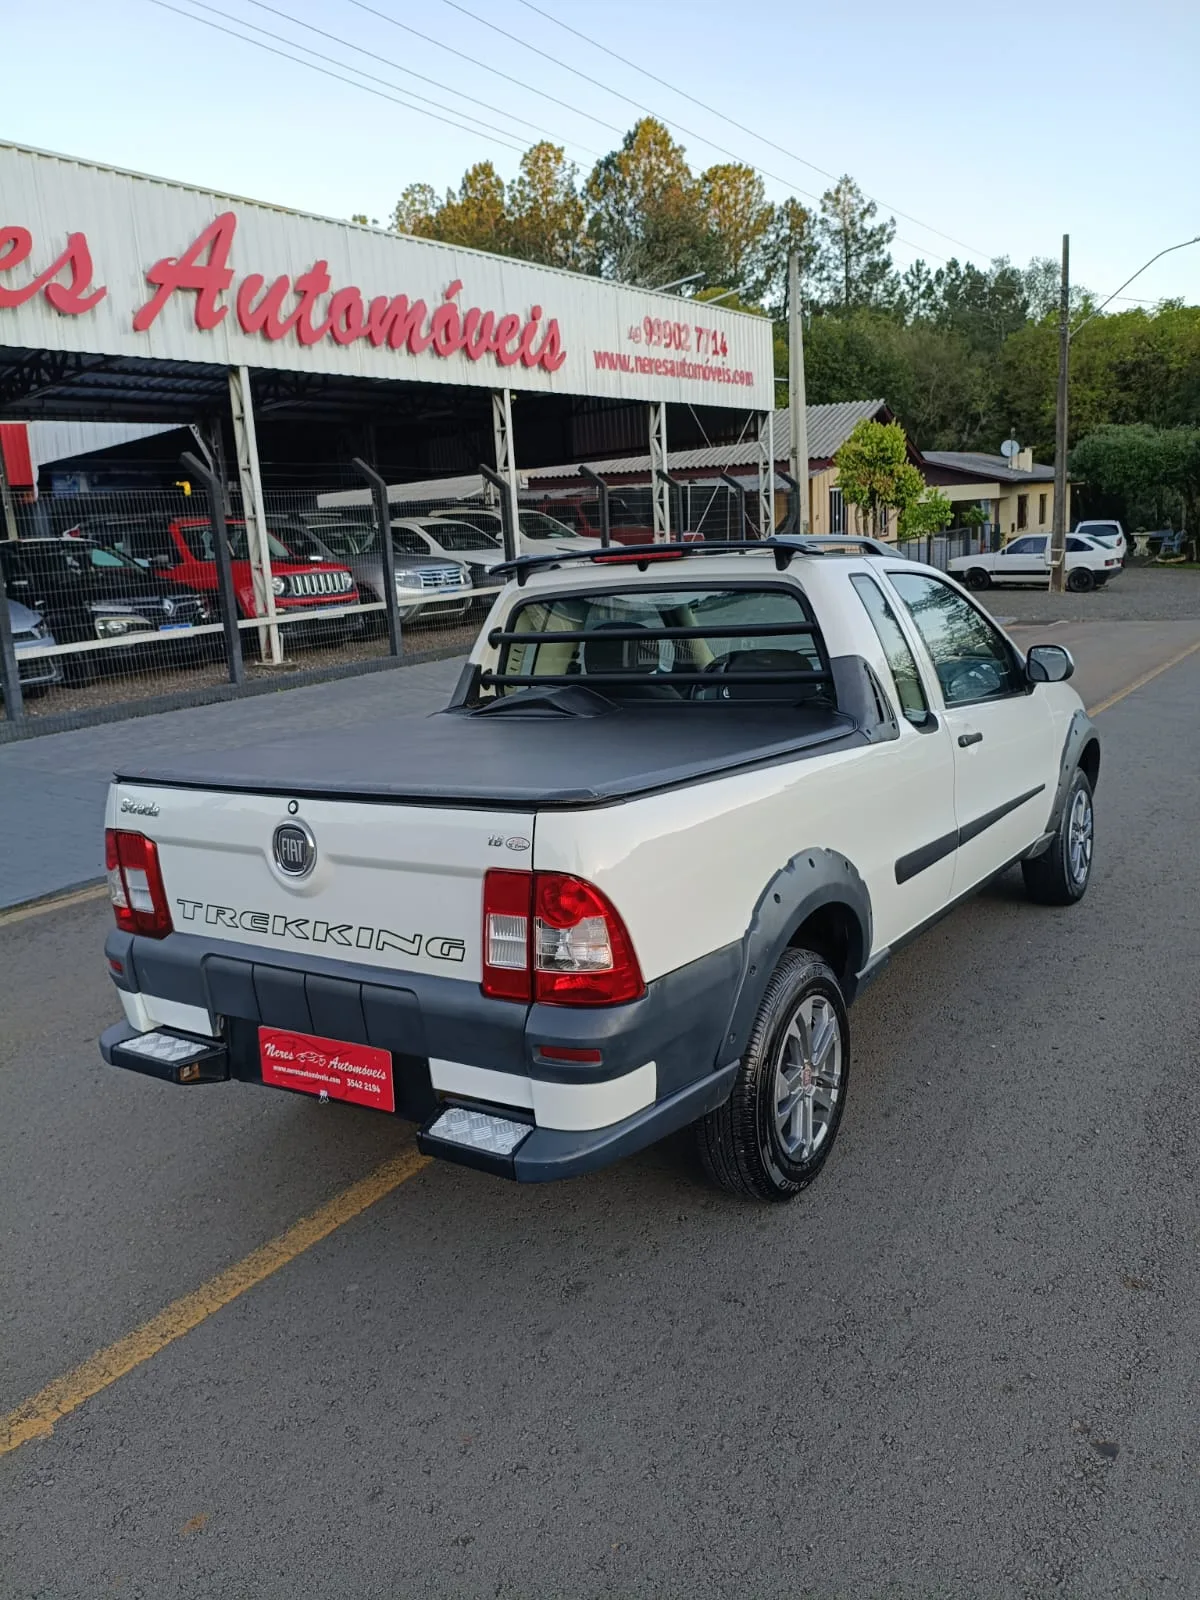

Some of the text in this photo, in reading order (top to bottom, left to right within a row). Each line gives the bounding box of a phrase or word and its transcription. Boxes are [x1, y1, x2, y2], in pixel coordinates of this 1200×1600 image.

[133, 211, 566, 372] Automóveis
[643, 316, 691, 352] 99902
[695, 326, 728, 358] 7714
[120, 798, 160, 816] Strada
[282, 836, 304, 863] FIAT
[176, 898, 466, 962] TREKKING
[264, 1042, 387, 1080] Neres Automóveis
[346, 1078, 363, 1089] 3542
